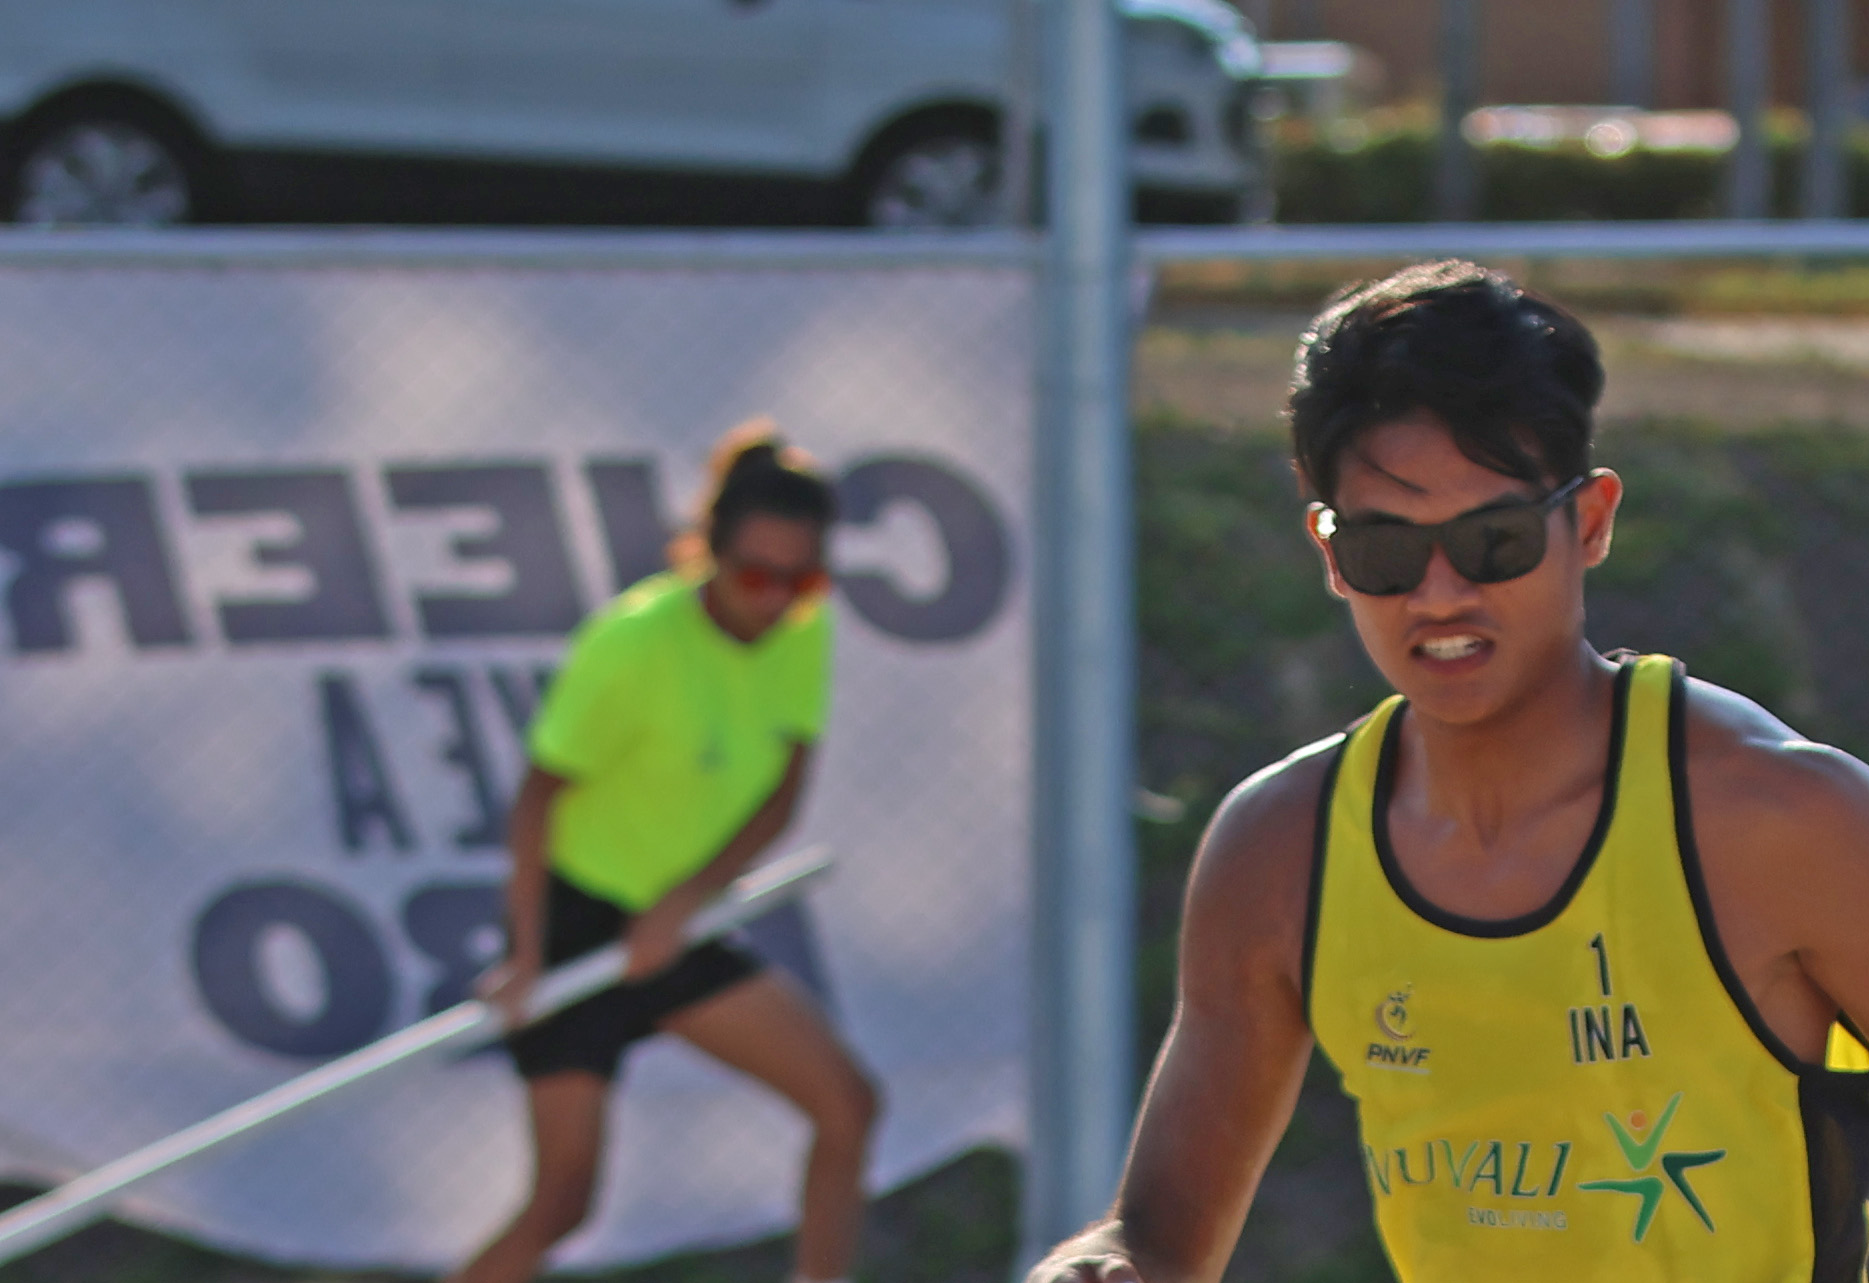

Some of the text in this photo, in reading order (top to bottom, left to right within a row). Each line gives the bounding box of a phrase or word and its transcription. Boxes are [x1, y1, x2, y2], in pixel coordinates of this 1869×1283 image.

[1590, 932, 1613, 996] 1
[1367, 1042, 1431, 1066] PNVF
[1569, 1003, 1651, 1064] INA
[1364, 1139, 1572, 1197] NUVALI
